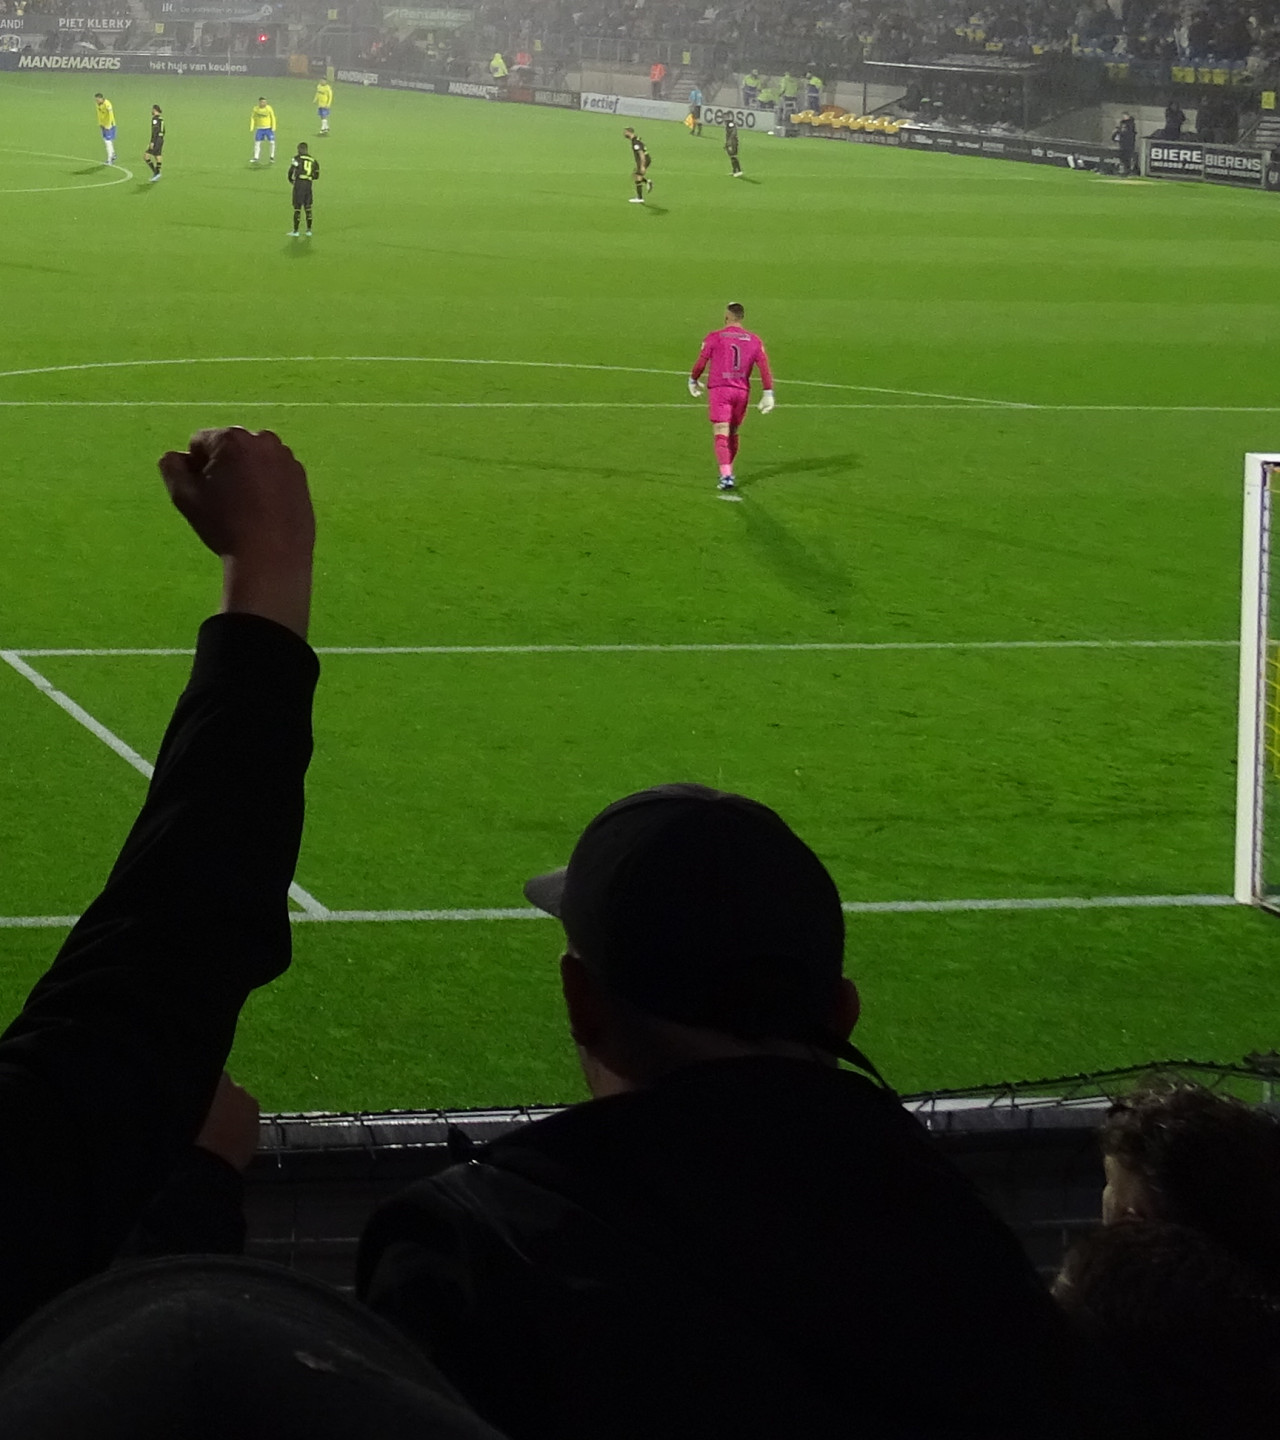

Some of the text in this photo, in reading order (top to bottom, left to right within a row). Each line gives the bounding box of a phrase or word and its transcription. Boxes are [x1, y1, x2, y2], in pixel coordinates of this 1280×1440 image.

[59, 18, 84, 28] PIET
[18, 55, 121, 69] MANDEMAKERS
[167, 61, 187, 71] huis
[189, 63, 206, 72] van
[208, 62, 247, 72] keukens
[591, 95, 620, 114] actief
[304, 160, 312, 176] 4
[1205, 154, 1261, 171] BIERENS
[731, 344, 742, 371] 1
